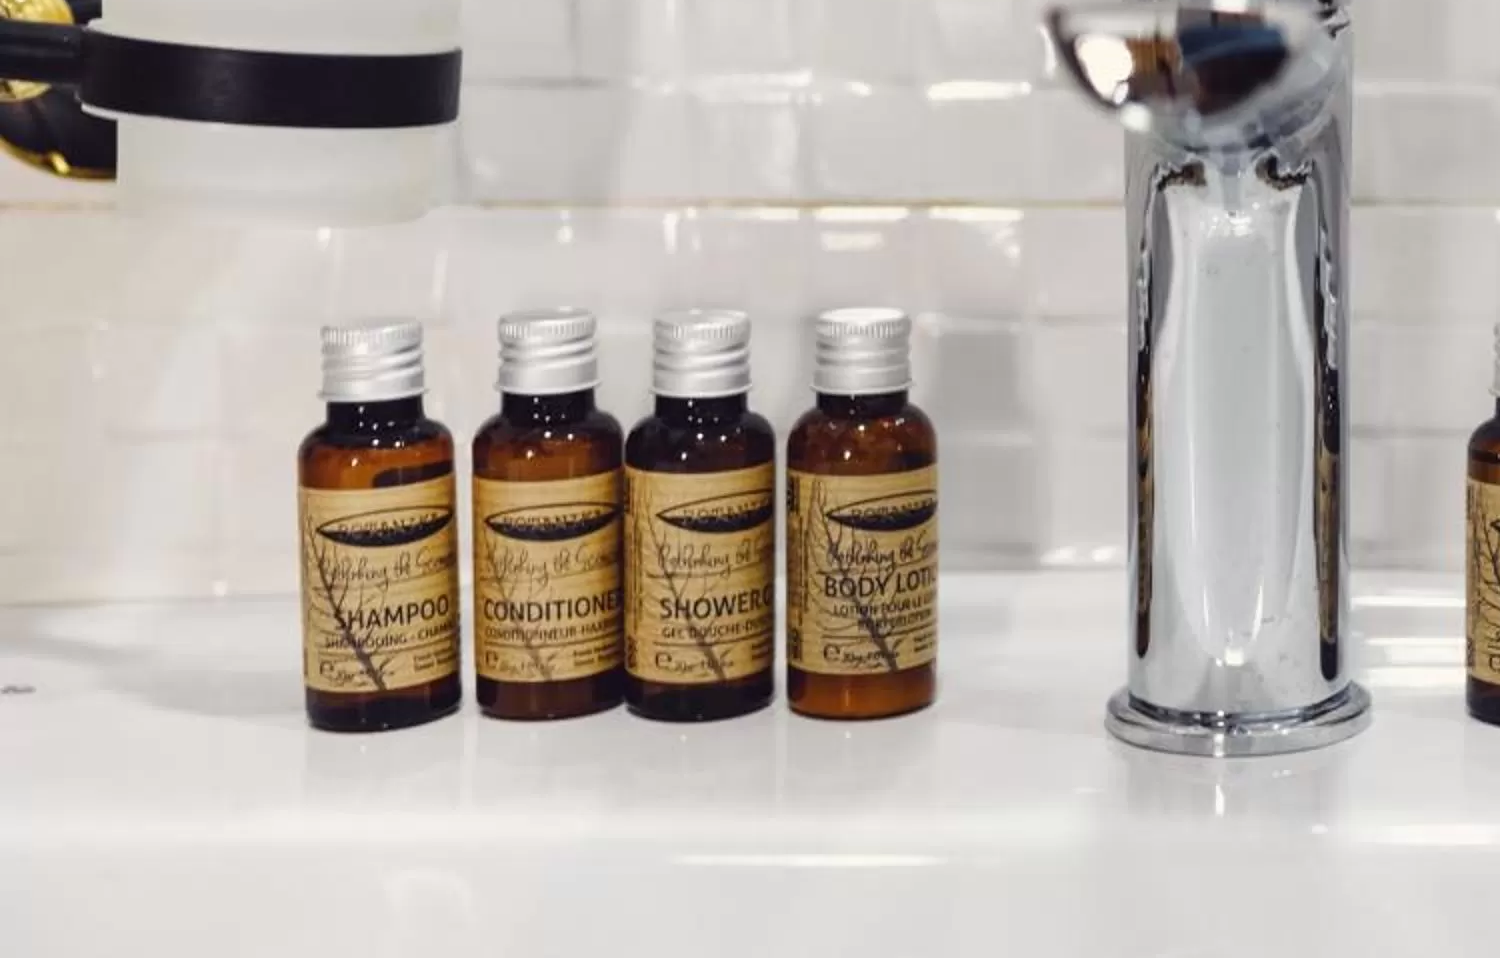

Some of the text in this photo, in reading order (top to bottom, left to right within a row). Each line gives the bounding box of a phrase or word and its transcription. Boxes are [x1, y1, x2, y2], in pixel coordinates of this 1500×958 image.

[824, 567, 936, 598] BODY LOTI
[335, 593, 449, 630] SHAMPOO
[484, 590, 618, 622] CONDITIONE
[659, 591, 762, 621] SHOWER
